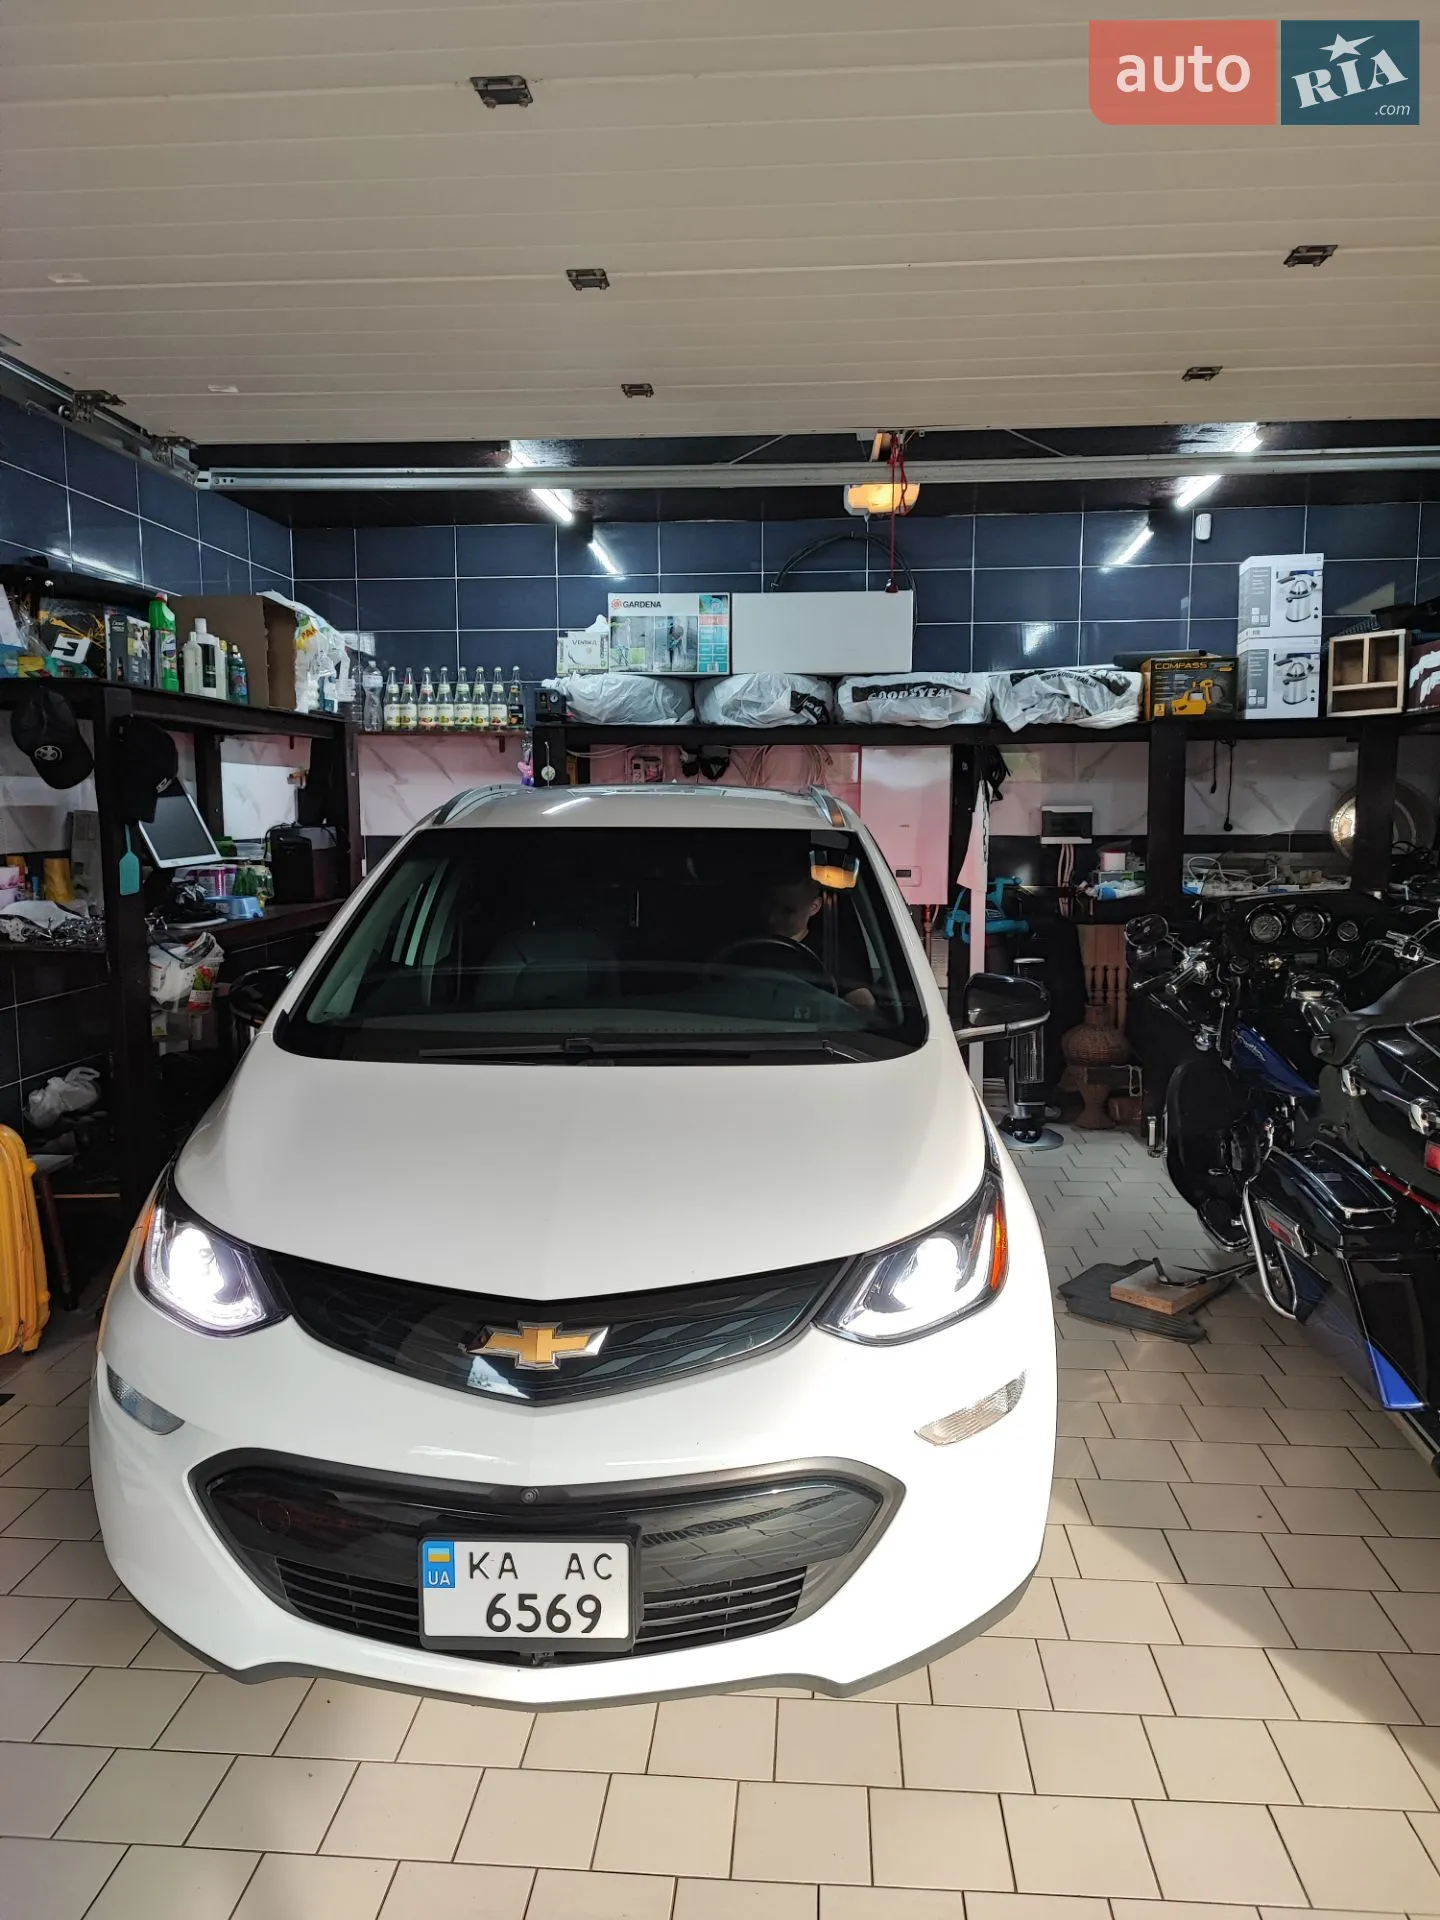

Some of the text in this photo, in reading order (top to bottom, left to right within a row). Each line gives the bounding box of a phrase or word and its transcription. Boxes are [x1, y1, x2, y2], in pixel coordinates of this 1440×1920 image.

[622, 600, 662, 609] GARDENA
[1154, 662, 1208, 670] COMPASS
[468, 1551, 613, 1581] KA AC
[427, 1570, 451, 1586] UA
[486, 1592, 602, 1634] 6569
